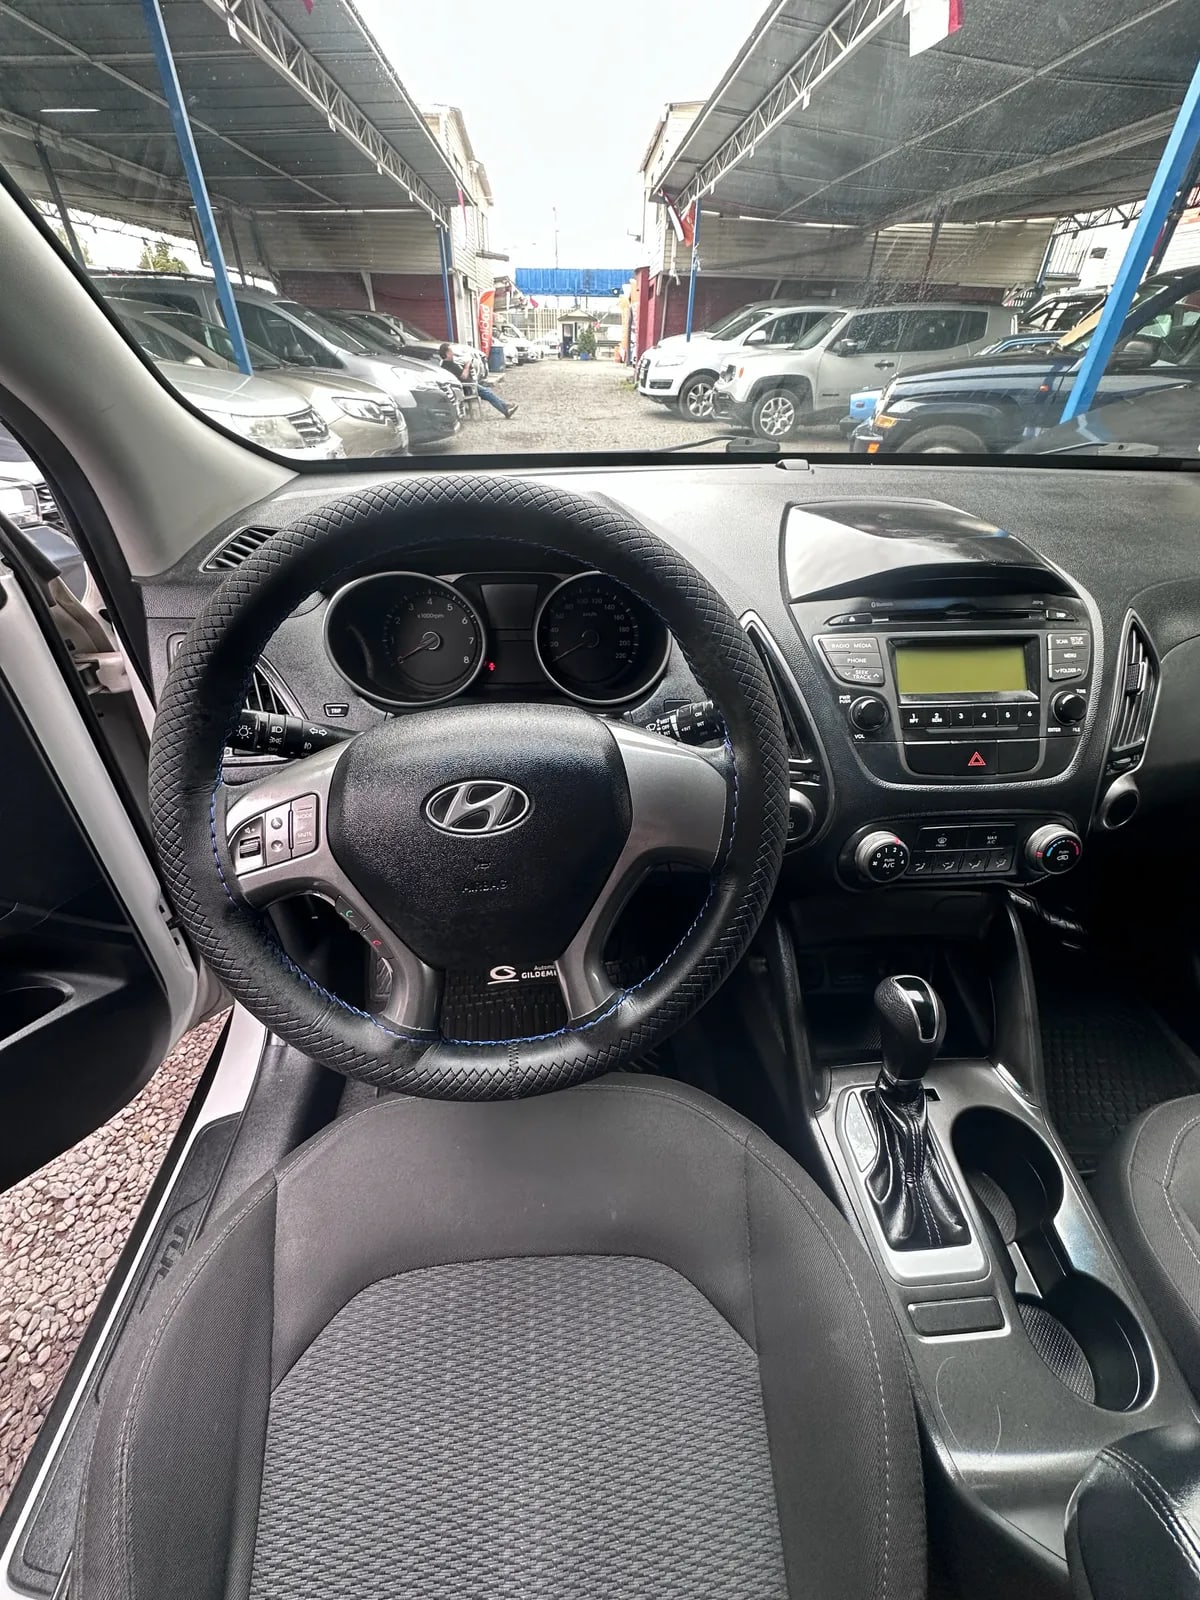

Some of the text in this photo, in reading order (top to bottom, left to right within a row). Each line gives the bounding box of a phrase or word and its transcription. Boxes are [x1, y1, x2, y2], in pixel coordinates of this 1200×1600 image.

[468, 637, 474, 645] 7
[463, 656, 469, 664] 8
[521, 970, 558, 979] GILDEMI
